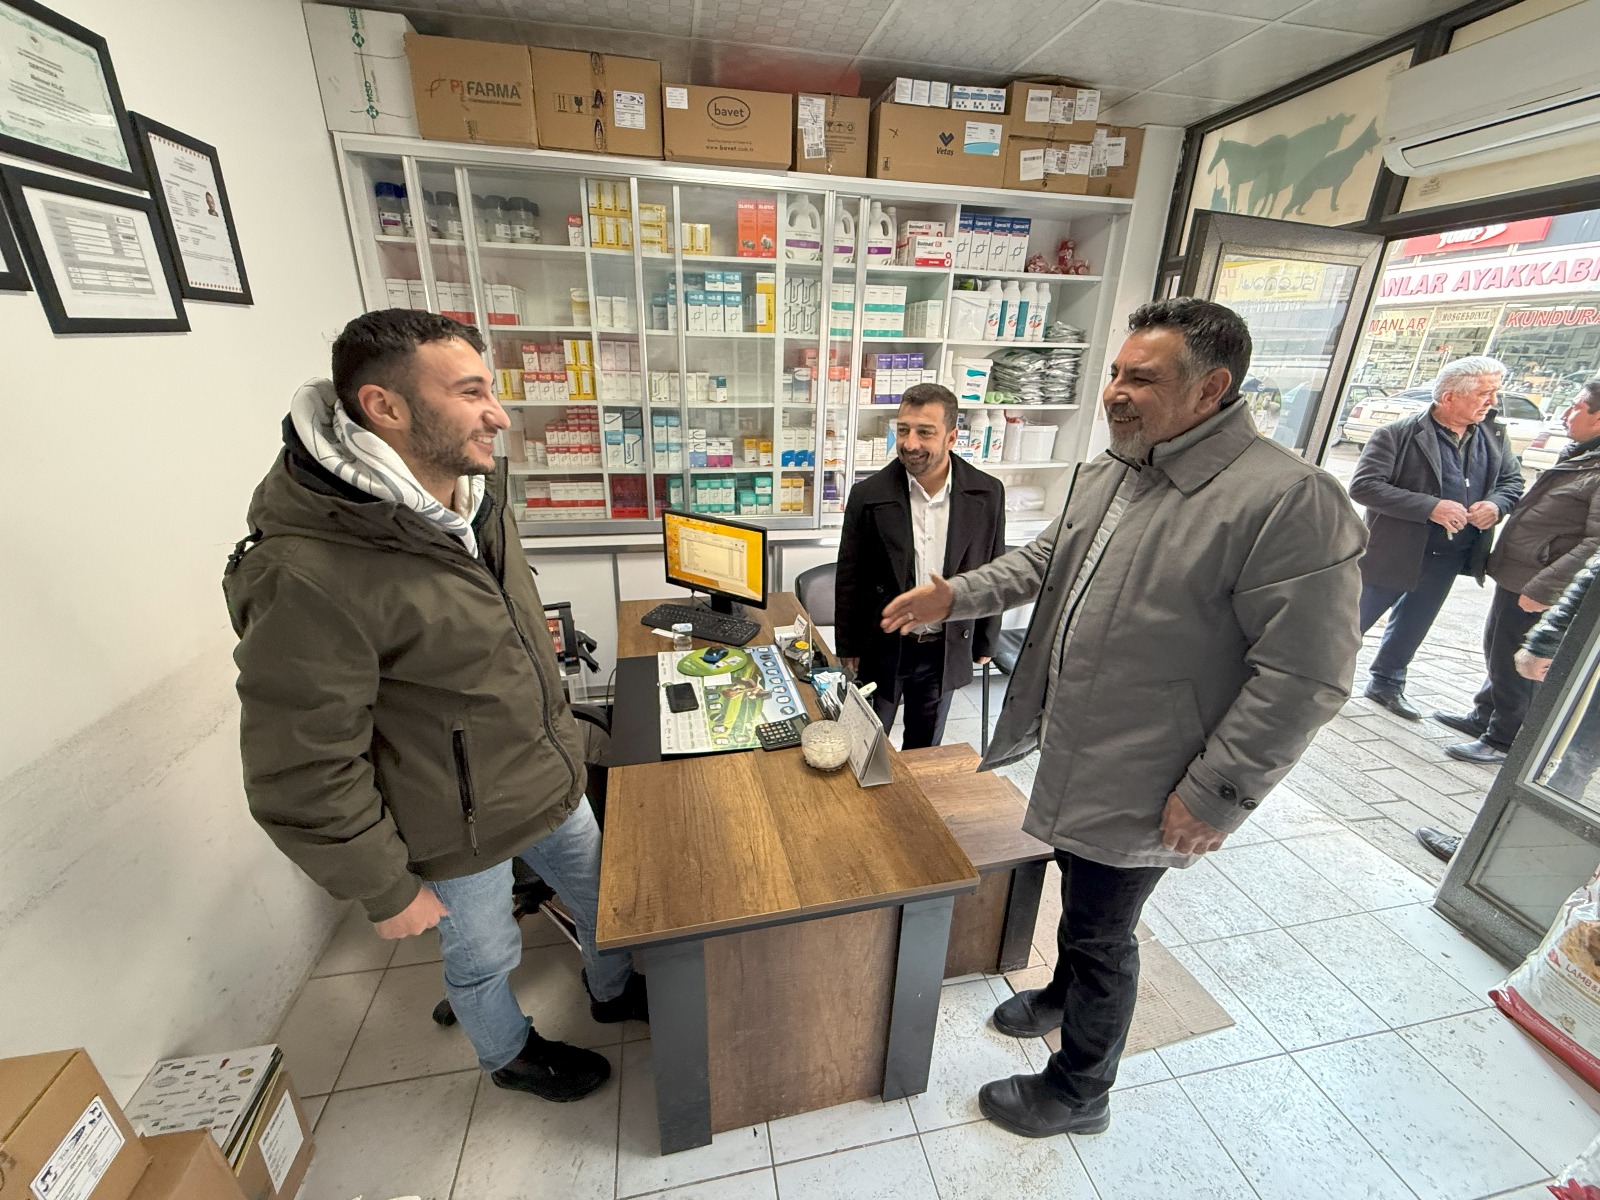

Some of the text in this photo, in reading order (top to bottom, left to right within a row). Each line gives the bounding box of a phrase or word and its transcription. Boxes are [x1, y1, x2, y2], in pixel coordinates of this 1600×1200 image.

[364, 80, 375, 103] MSD
[714, 102, 745, 118] bavet
[1565, 963, 1592, 986] LAMB
